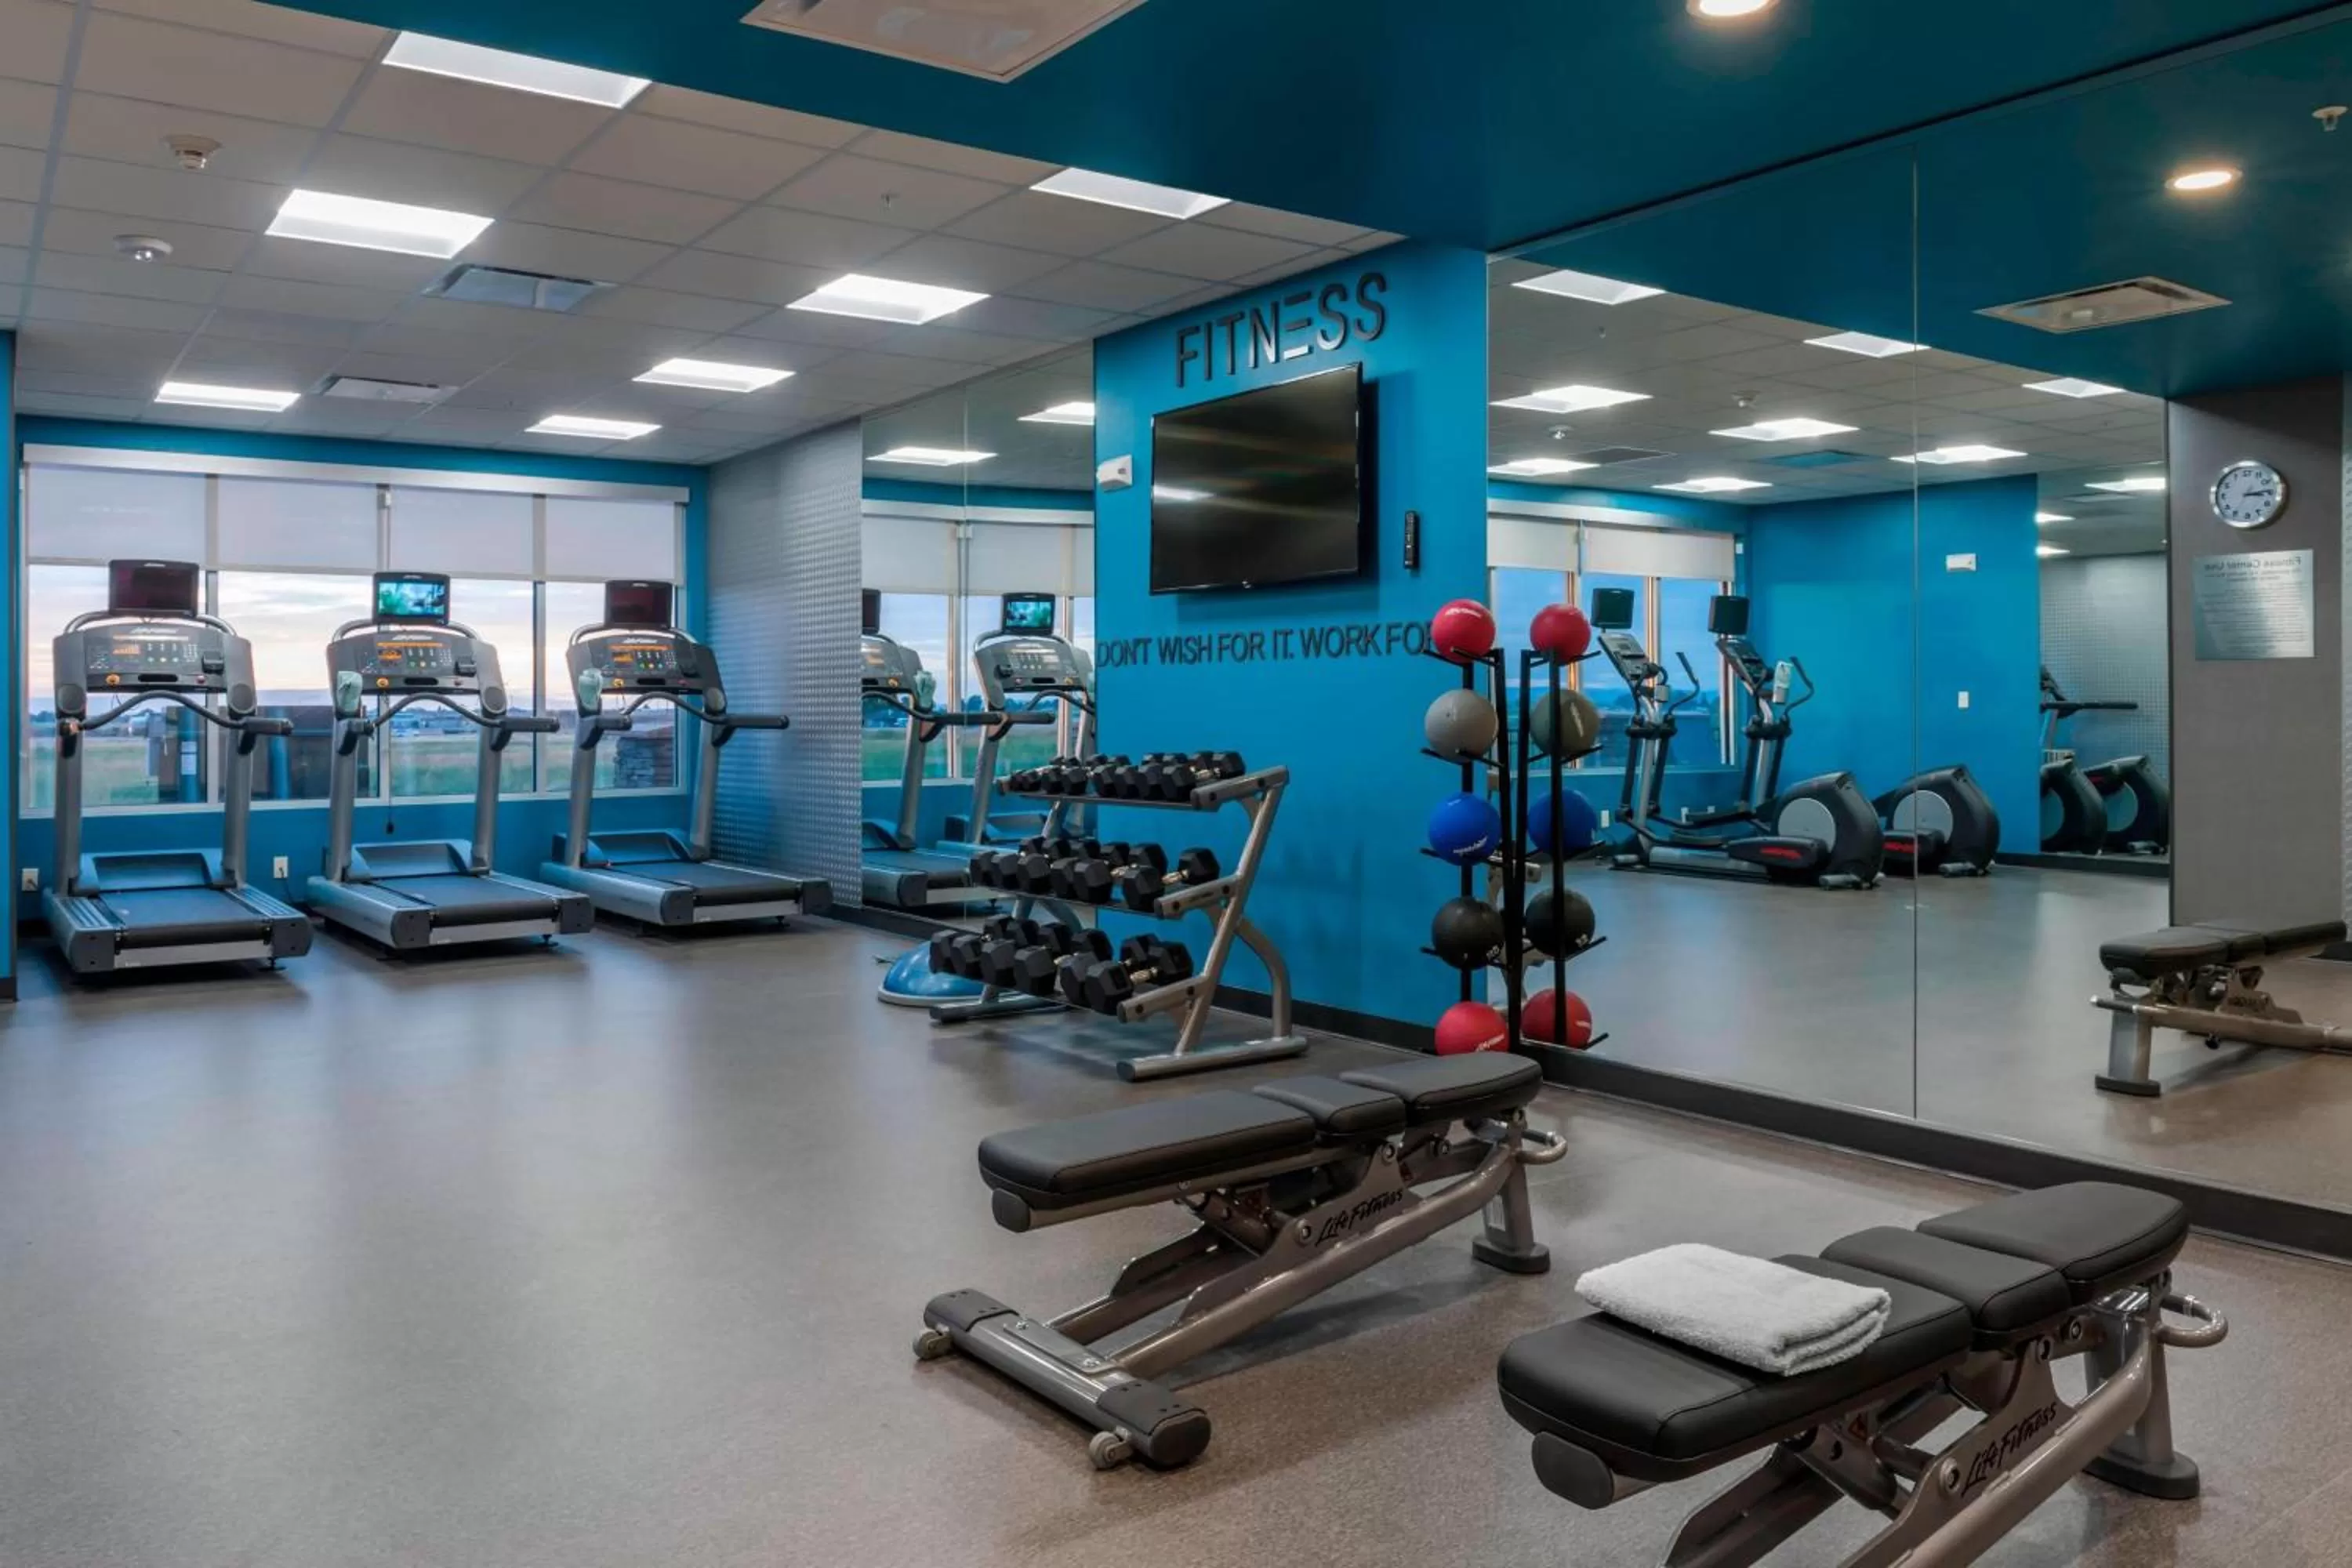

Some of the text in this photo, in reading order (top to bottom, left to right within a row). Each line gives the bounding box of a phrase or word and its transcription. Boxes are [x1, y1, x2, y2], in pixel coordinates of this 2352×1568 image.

[1178, 272, 1387, 388] FITNESS
[1157, 633, 1212, 665] WISH
[1217, 631, 1266, 663] FOR
[1273, 629, 1294, 660] IT.
[1301, 624, 1381, 659] WORK
[1316, 1189, 1402, 1247] Life Fitness
[1961, 1401, 2056, 1497] Life Fitness
